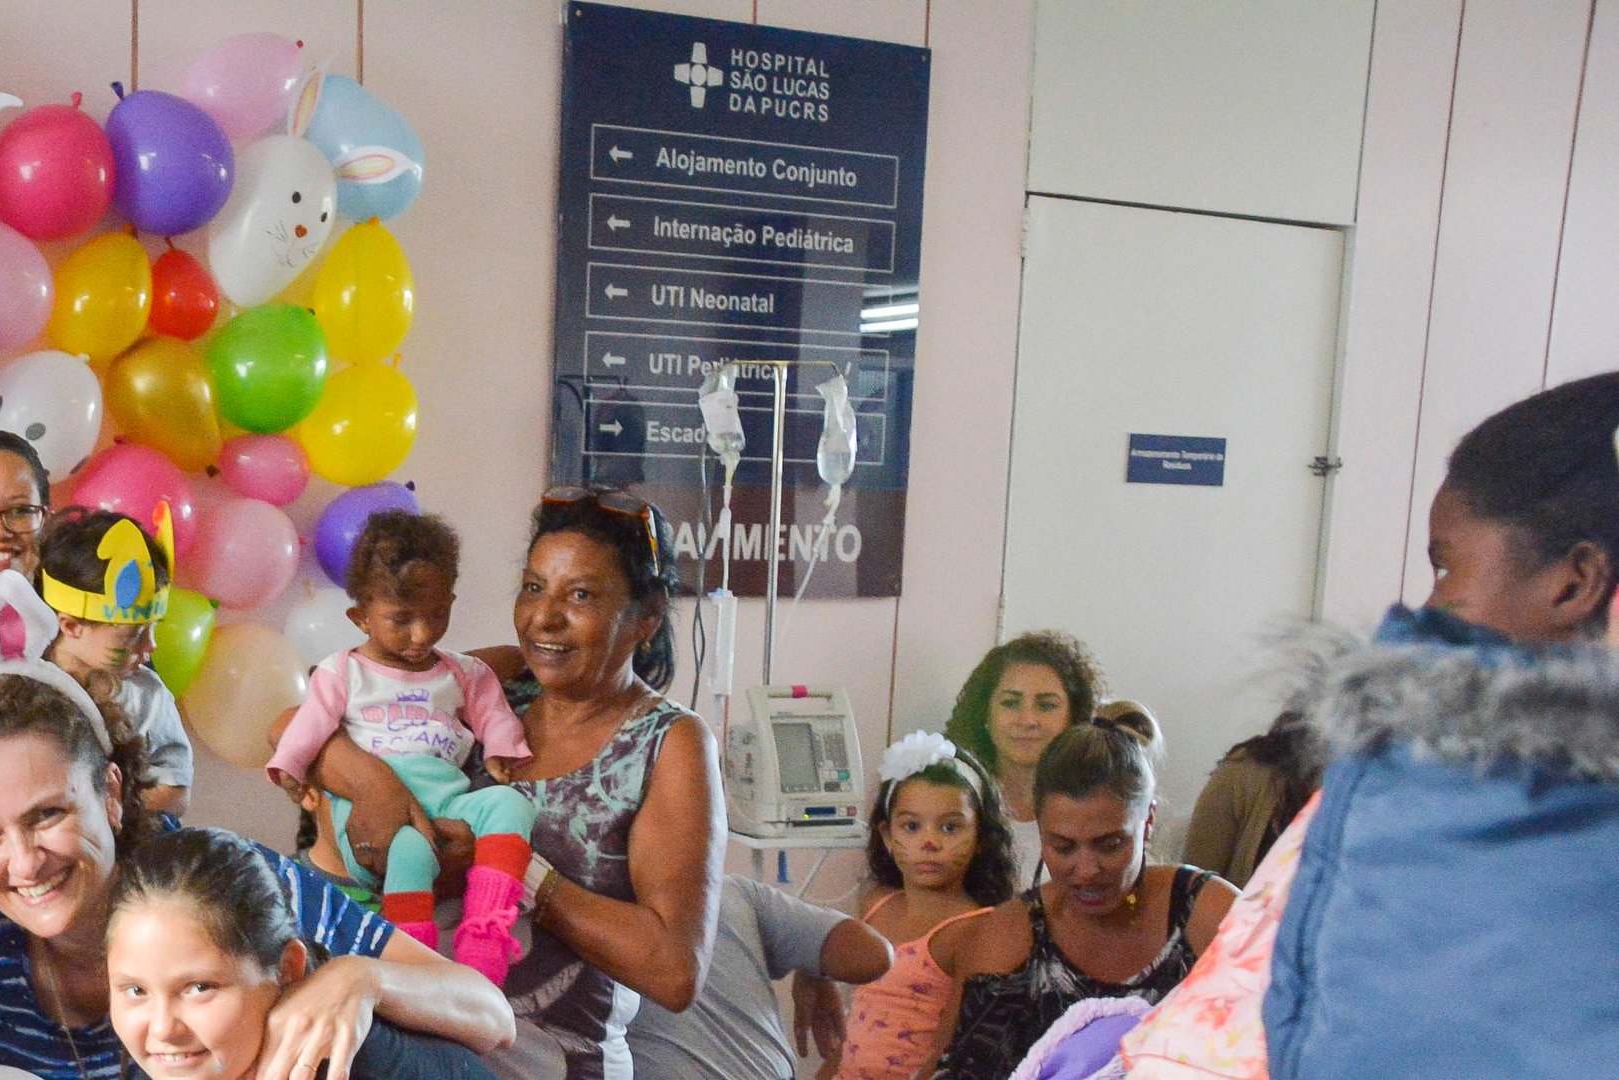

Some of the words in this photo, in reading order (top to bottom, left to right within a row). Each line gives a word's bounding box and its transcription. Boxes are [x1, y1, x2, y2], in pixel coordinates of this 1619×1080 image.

[730, 48, 830, 78] HOSPITAL
[730, 68, 768, 92] SÃO
[772, 76, 830, 100] LUCAS
[655, 147, 767, 178] Alojamento
[772, 158, 858, 188] Conjunto
[653, 216, 757, 248] Internação
[761, 225, 855, 254] Pediátrica
[651, 284, 685, 308] UTI
[689, 287, 775, 313] Neonatal
[648, 353, 682, 375] UTI
[645, 420, 707, 443] Escad
